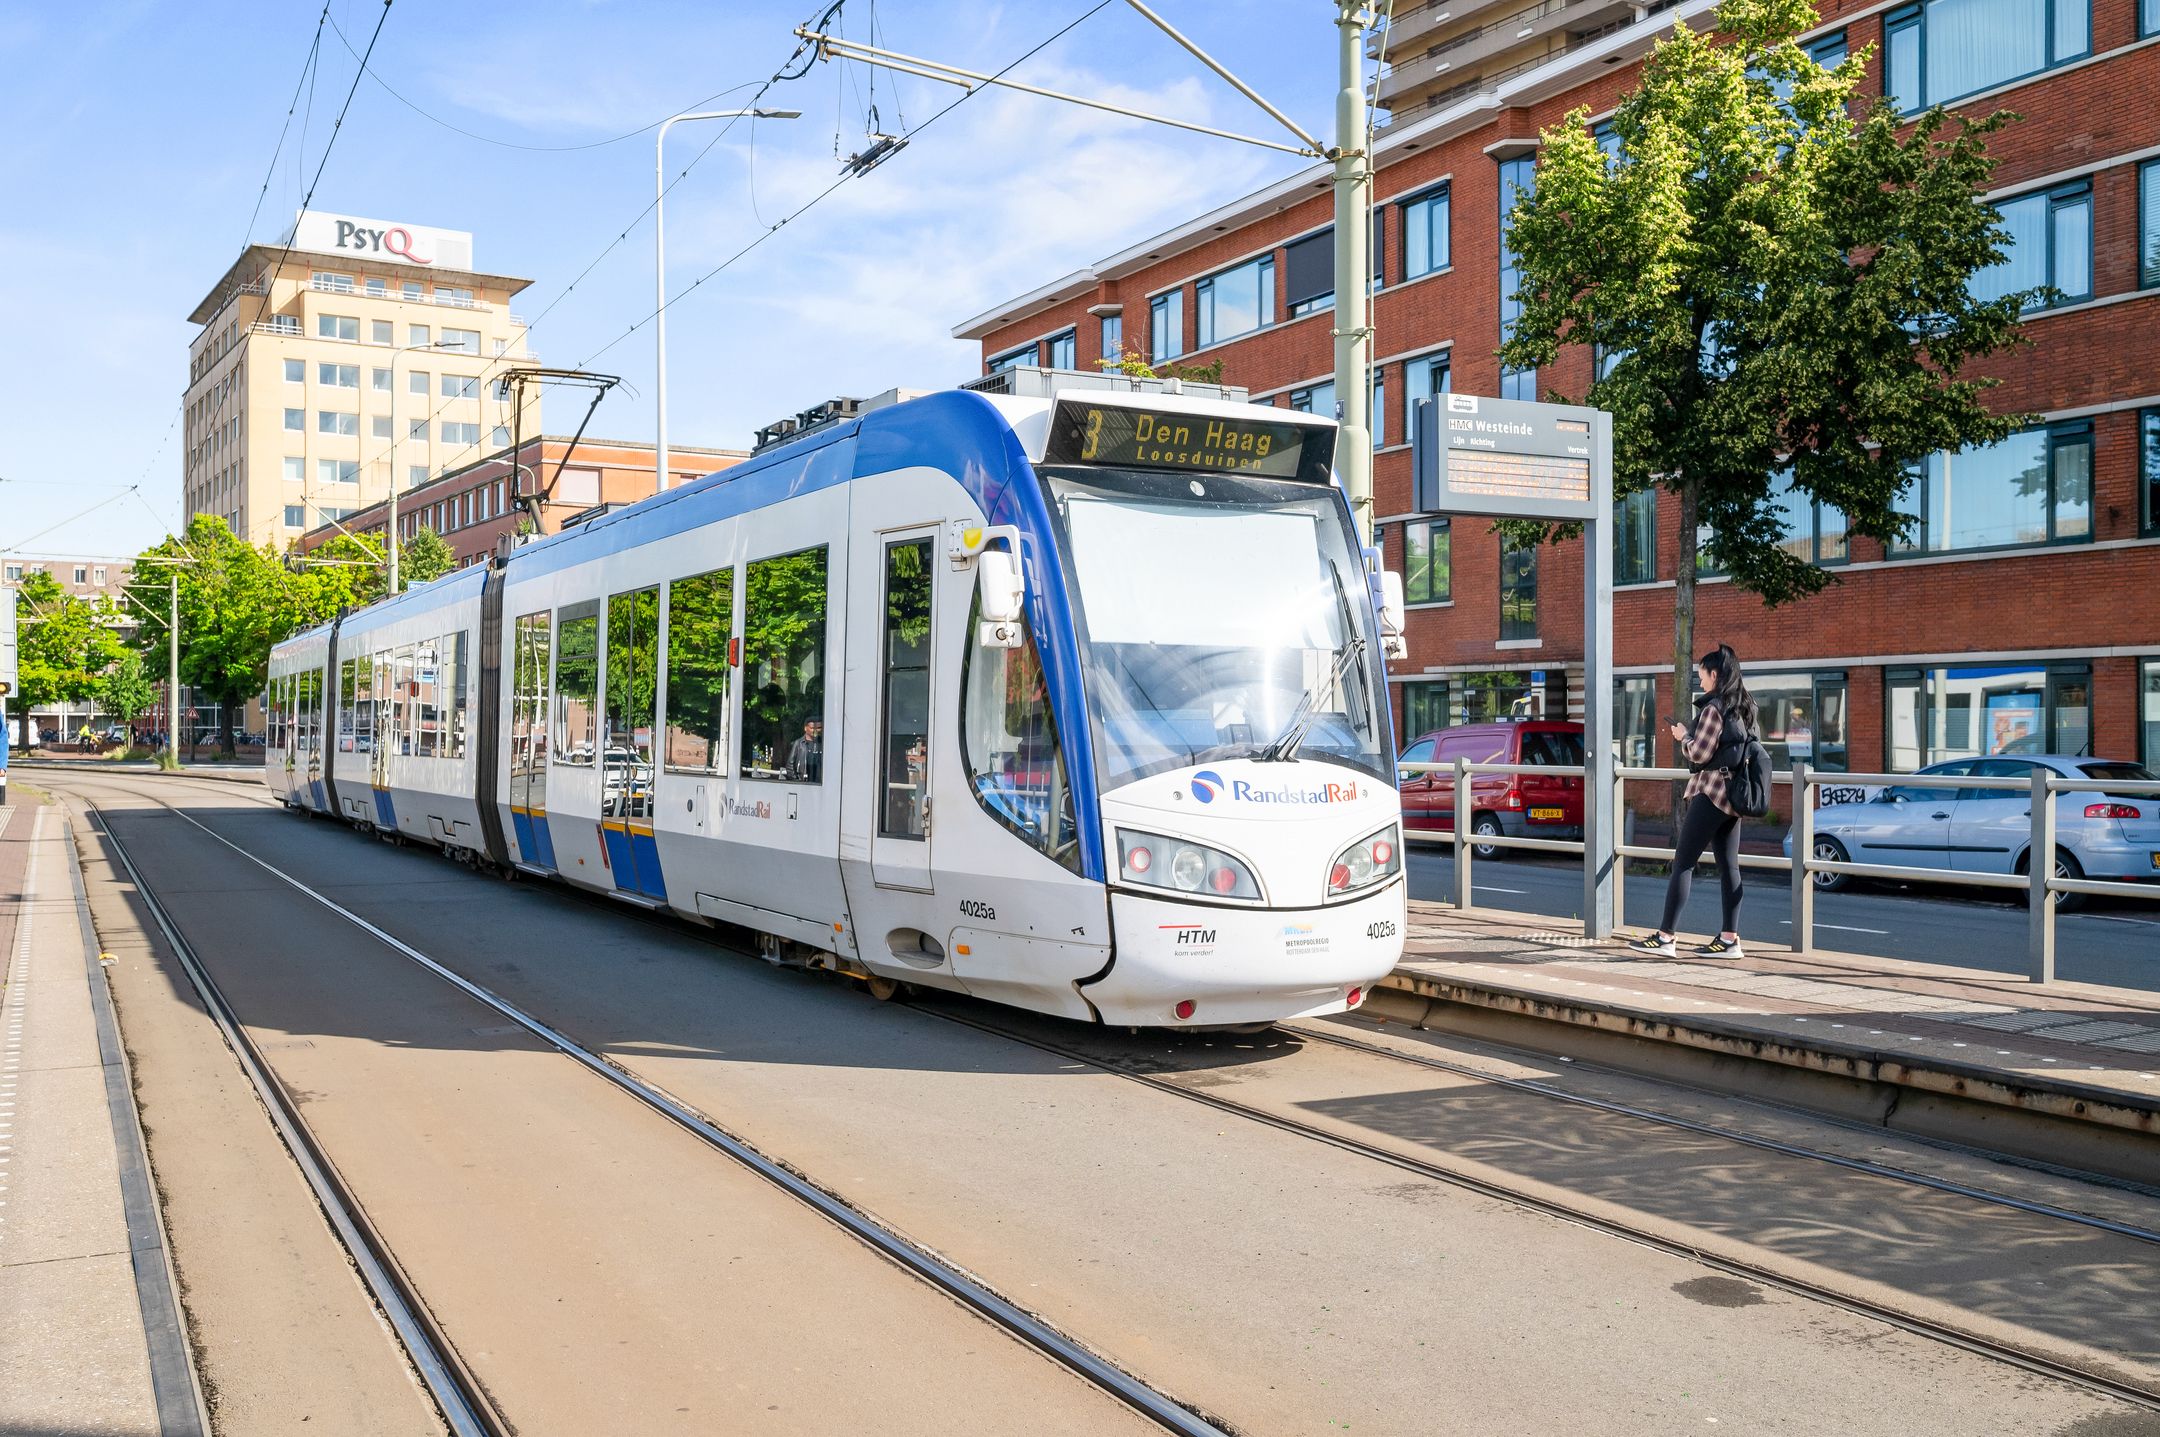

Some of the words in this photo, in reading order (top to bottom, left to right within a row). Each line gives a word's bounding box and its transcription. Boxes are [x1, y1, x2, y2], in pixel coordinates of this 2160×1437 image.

[1081, 409, 1103, 460] 3
[1135, 414, 1189, 446] Den
[1204, 420, 1273, 457] Haag
[1475, 420, 1533, 436] Westeinde
[1453, 436, 1465, 446] Lijn
[1470, 437, 1495, 448] Richting
[1567, 446, 1588, 455] Vertrek
[1136, 446, 1263, 470] Loosduinen
[1232, 780, 1357, 804] RandstadRail
[729, 798, 771, 819] RandstadRail
[959, 899, 996, 921] 4025a
[1177, 930, 1216, 943] HTM
[1366, 920, 1396, 940] 4025a
